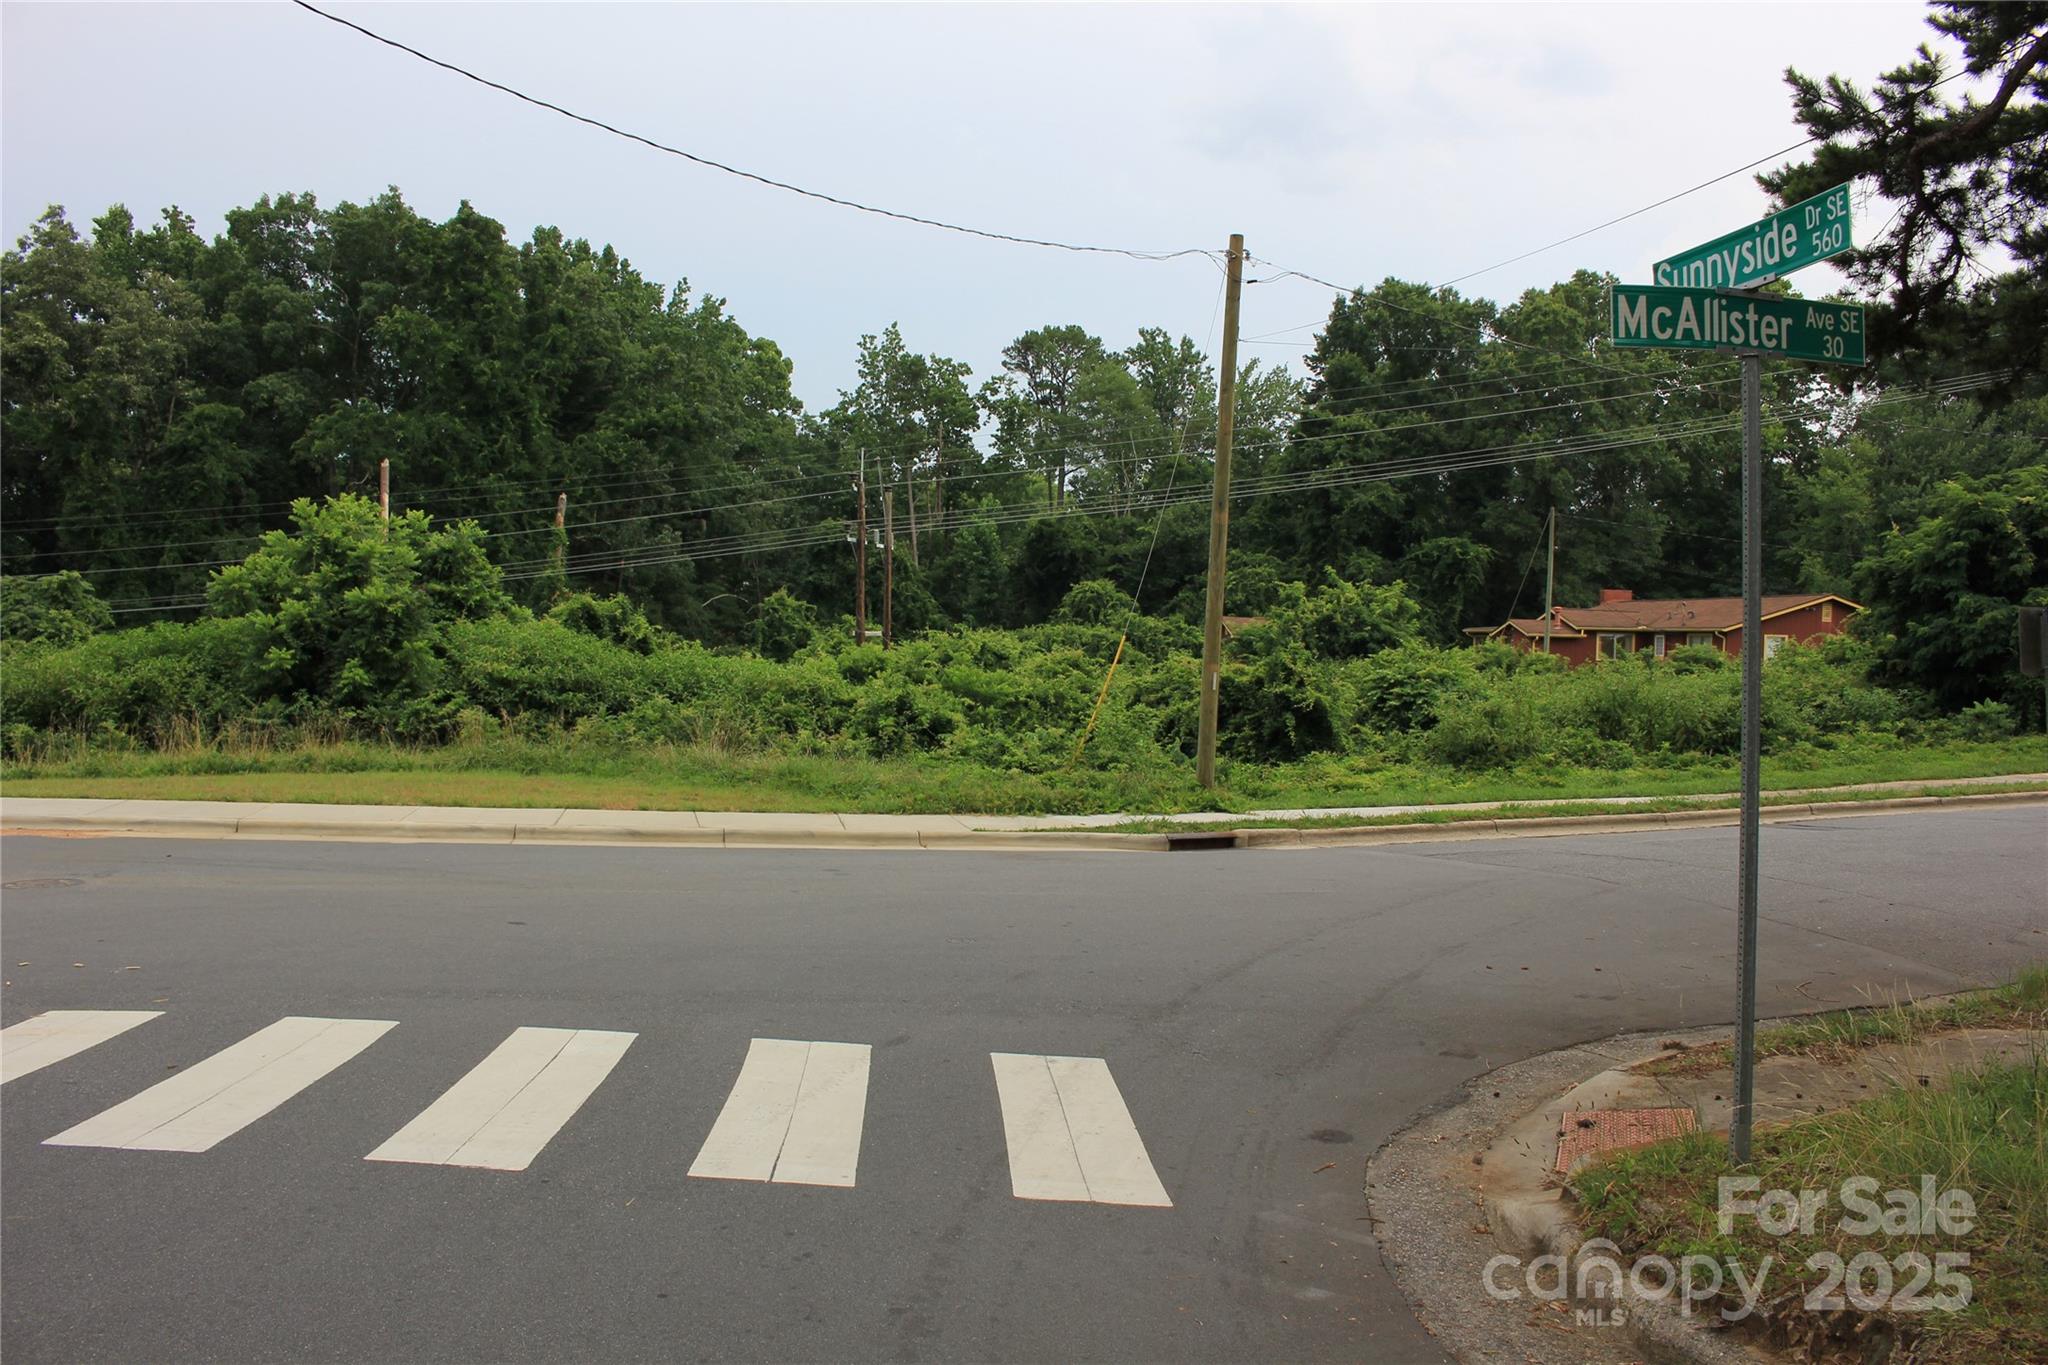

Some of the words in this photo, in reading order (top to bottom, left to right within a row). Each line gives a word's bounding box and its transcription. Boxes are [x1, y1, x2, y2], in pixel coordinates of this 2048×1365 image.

[1657, 218, 1798, 288] Sunnyside
[1805, 205, 1822, 230] Dr
[1826, 191, 1847, 220] SE
[1812, 223, 1843, 257] 560
[1617, 294, 1793, 350] McAllister
[1805, 307, 1835, 330] Ave
[1840, 311, 1860, 334] SE
[1822, 335, 1844, 359] 30
